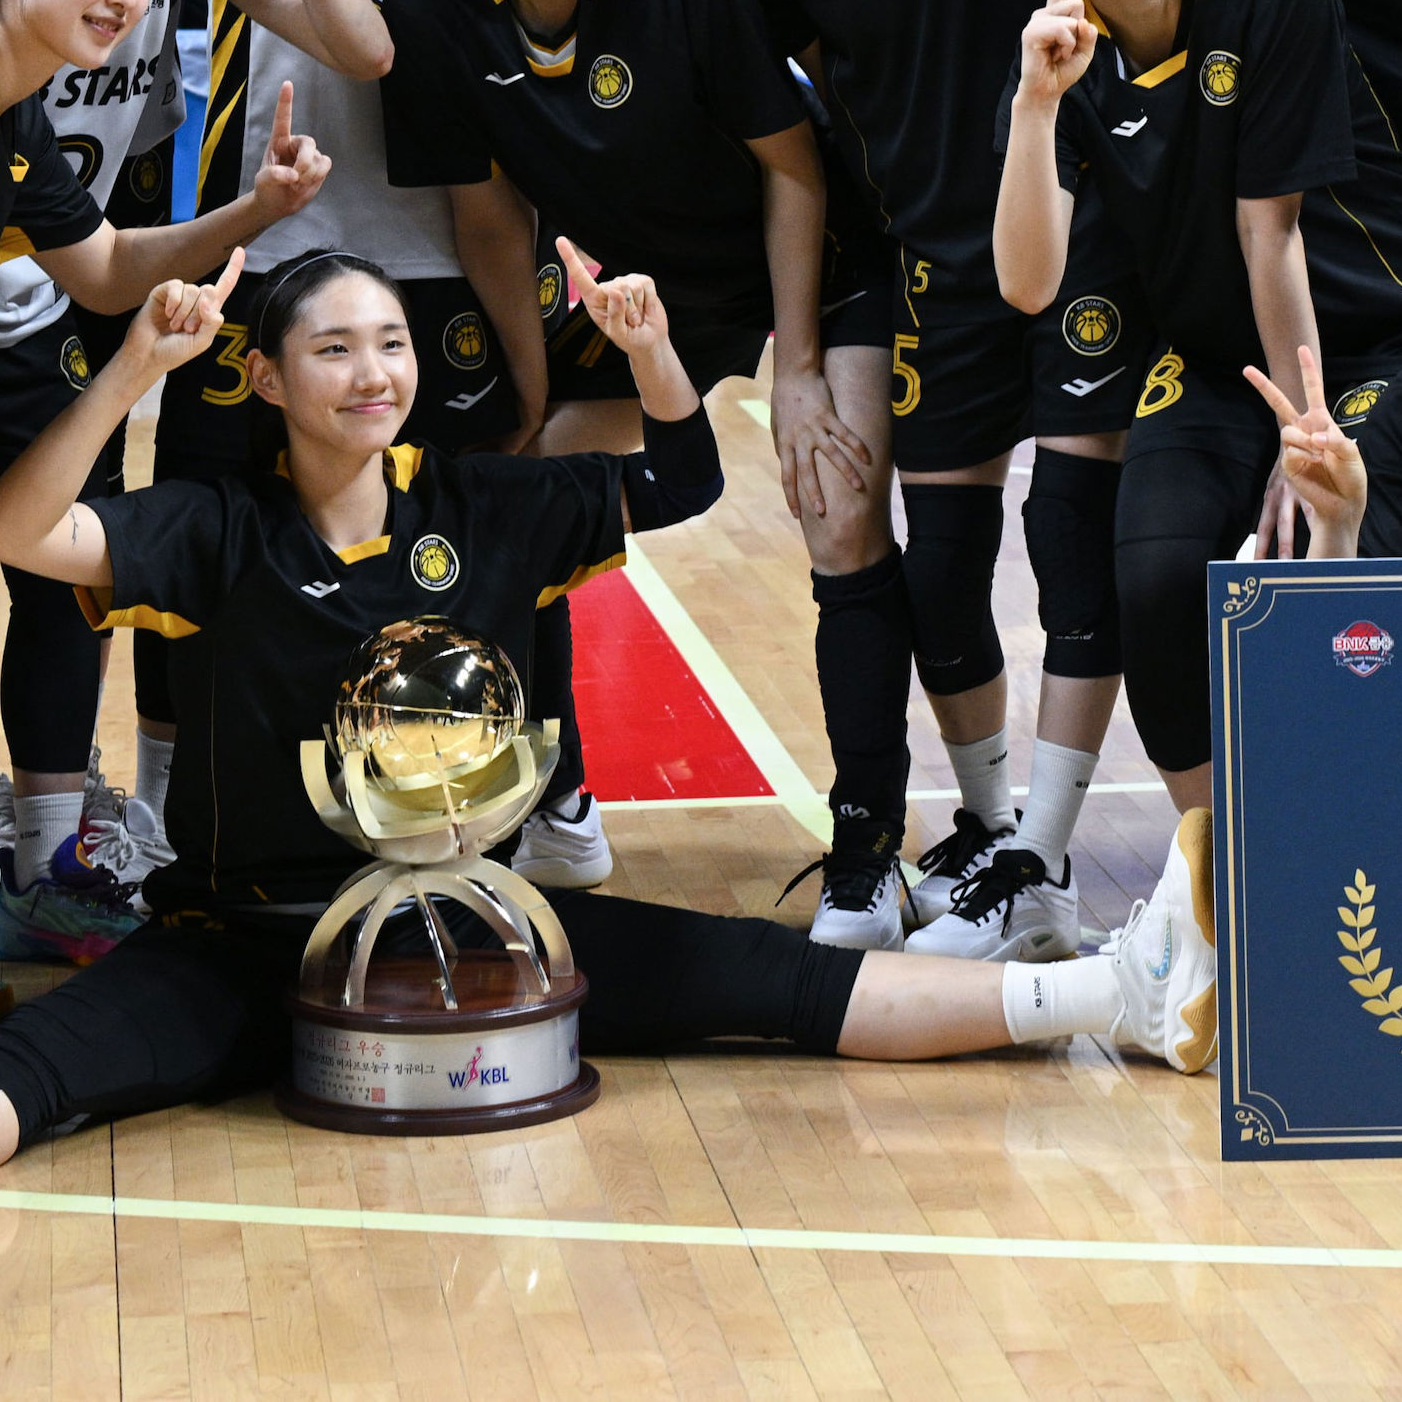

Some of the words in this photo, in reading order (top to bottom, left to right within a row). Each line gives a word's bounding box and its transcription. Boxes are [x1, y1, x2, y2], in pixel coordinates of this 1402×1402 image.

[911, 259, 933, 294] 5
[891, 333, 922, 417] 5
[1135, 353, 1186, 419] 8
[356, 1039, 386, 1058] 우승
